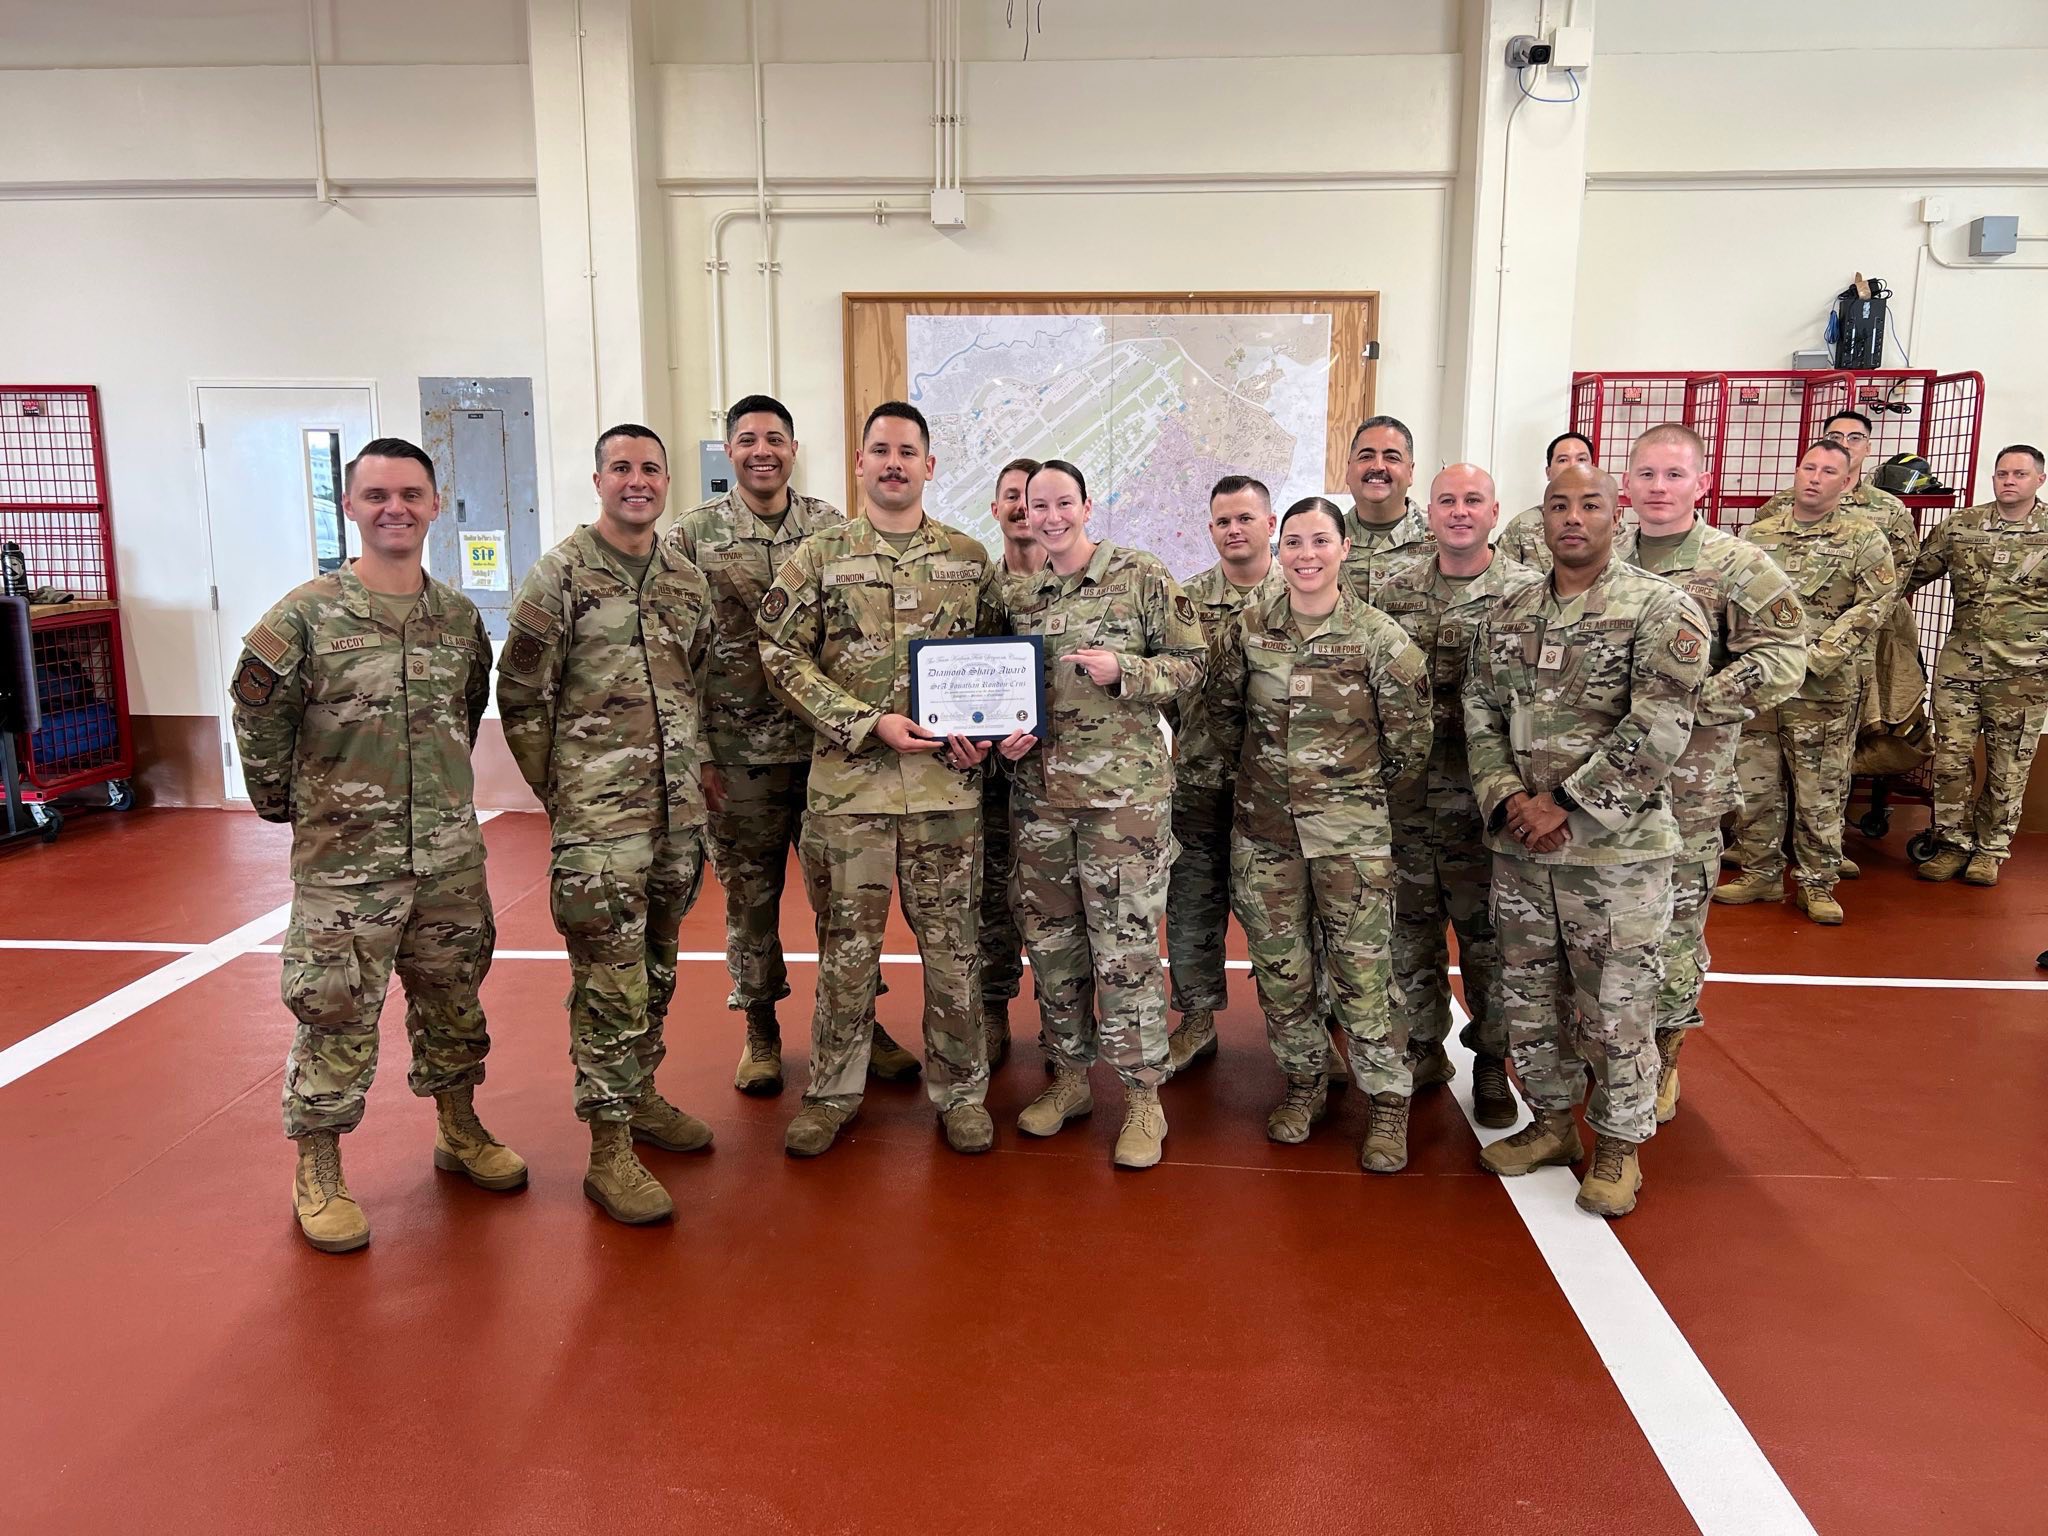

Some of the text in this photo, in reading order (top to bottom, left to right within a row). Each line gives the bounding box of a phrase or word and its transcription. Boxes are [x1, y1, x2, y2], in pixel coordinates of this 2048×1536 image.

[719, 552, 743, 561] TOVAR
[835, 573, 865, 583] RONDON
[946, 570, 956, 579] AIR
[956, 568, 976, 579] FORCE
[1106, 582, 1128, 593] FORCE
[1690, 584, 1713, 597] FORCE
[1594, 620, 1607, 630] AIR
[1609, 619, 1635, 630] FORCE
[331, 637, 365, 650] MCCOY
[1262, 639, 1288, 650] WOODS
[1330, 645, 1340, 653] AIR
[1342, 645, 1362, 653] FORCE
[927, 666, 1027, 677] Diamond Sharp Award
